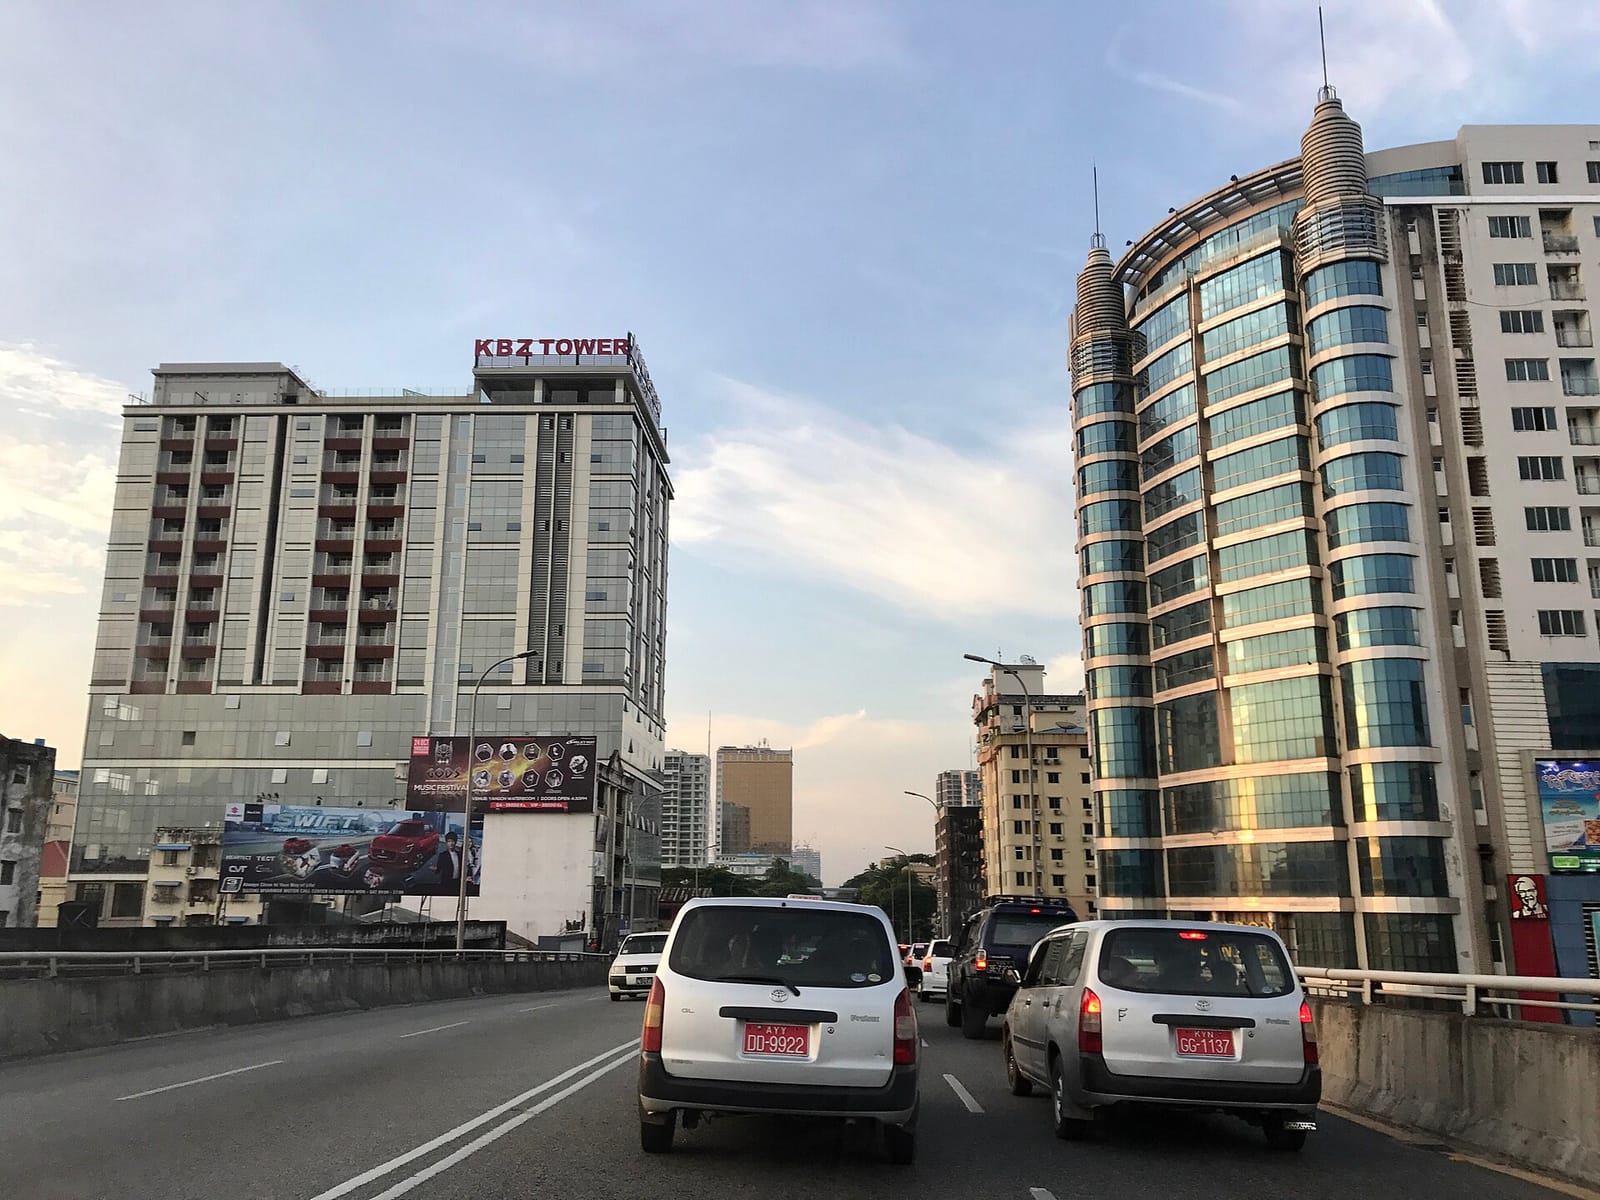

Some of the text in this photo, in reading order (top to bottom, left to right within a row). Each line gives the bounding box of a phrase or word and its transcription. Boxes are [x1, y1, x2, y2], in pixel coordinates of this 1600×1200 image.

[475, 339, 629, 356] KBZ TOWER
[276, 813, 359, 829] SWIFT
[228, 865, 248, 873] CVT
[765, 1026, 787, 1035] AYY
[1194, 1030, 1214, 1038] KYN
[747, 1034, 804, 1054] DD-9922
[1180, 1037, 1230, 1054] GG-1137
